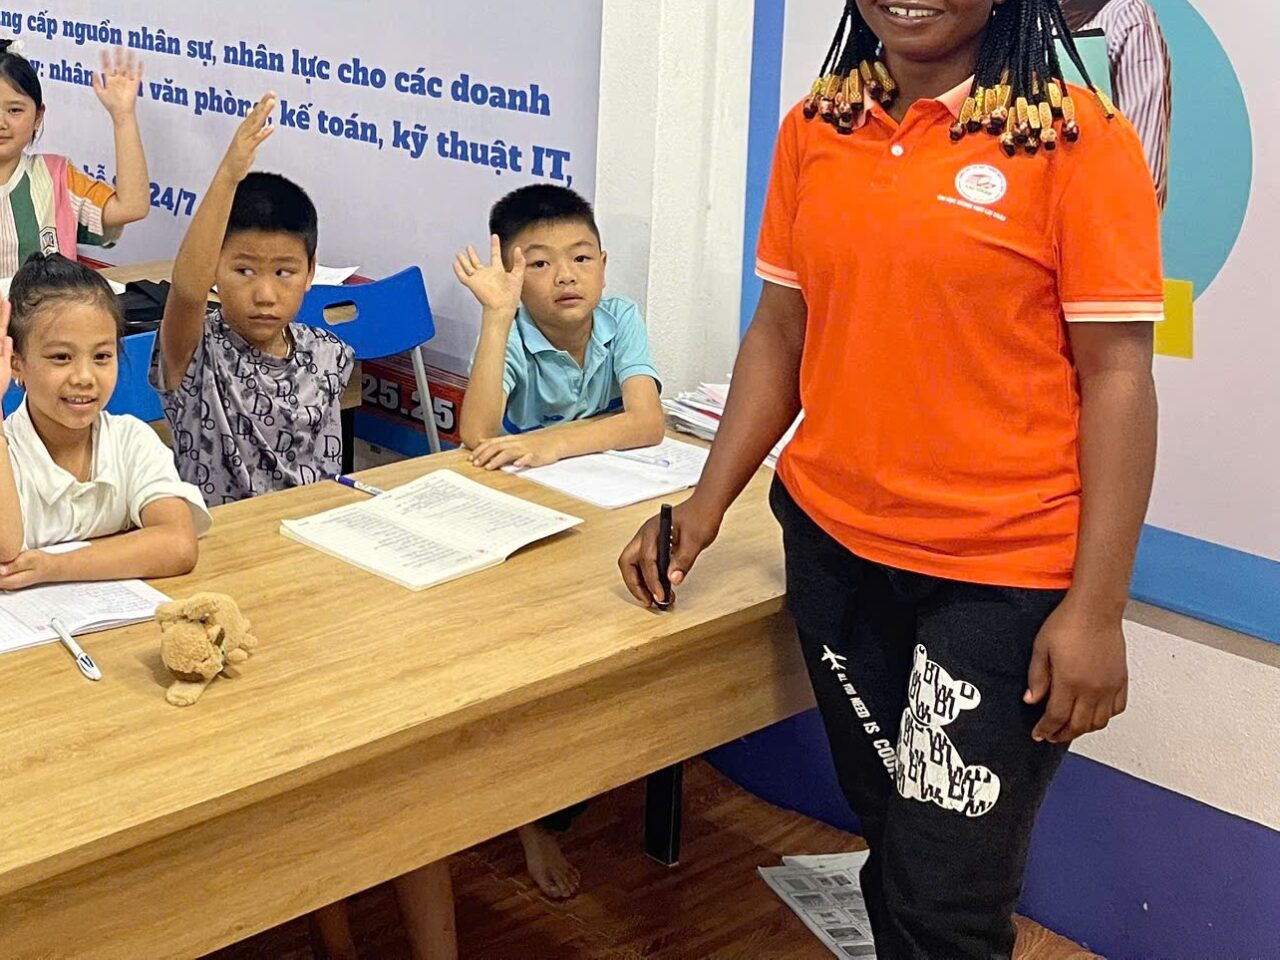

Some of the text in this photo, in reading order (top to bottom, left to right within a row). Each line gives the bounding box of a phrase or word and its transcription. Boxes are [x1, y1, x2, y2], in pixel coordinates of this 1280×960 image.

[27, 10, 57, 39] cấp
[62, 18, 122, 45] nguồn
[128, 26, 181, 55] nhân
[186, 39, 217, 66] sự,
[223, 41, 285, 72] nhân
[291, 49, 330, 84] lực
[337, 57, 387, 89] cho
[394, 67, 443, 98] các
[451, 73, 551, 116] doanh
[49, 59, 94, 87] nhân
[149, 77, 189, 106] văn
[194, 86, 272, 124] phòn,
[280, 100, 313, 130] kế
[317, 112, 384, 149] toán,
[392, 120, 429, 159] kỹ
[436, 131, 522, 175] thuật
[531, 145, 573, 188] IT,
[149, 182, 197, 217] 24/7
[849, 697, 871, 718] NEED
[863, 721, 880, 735] IS
